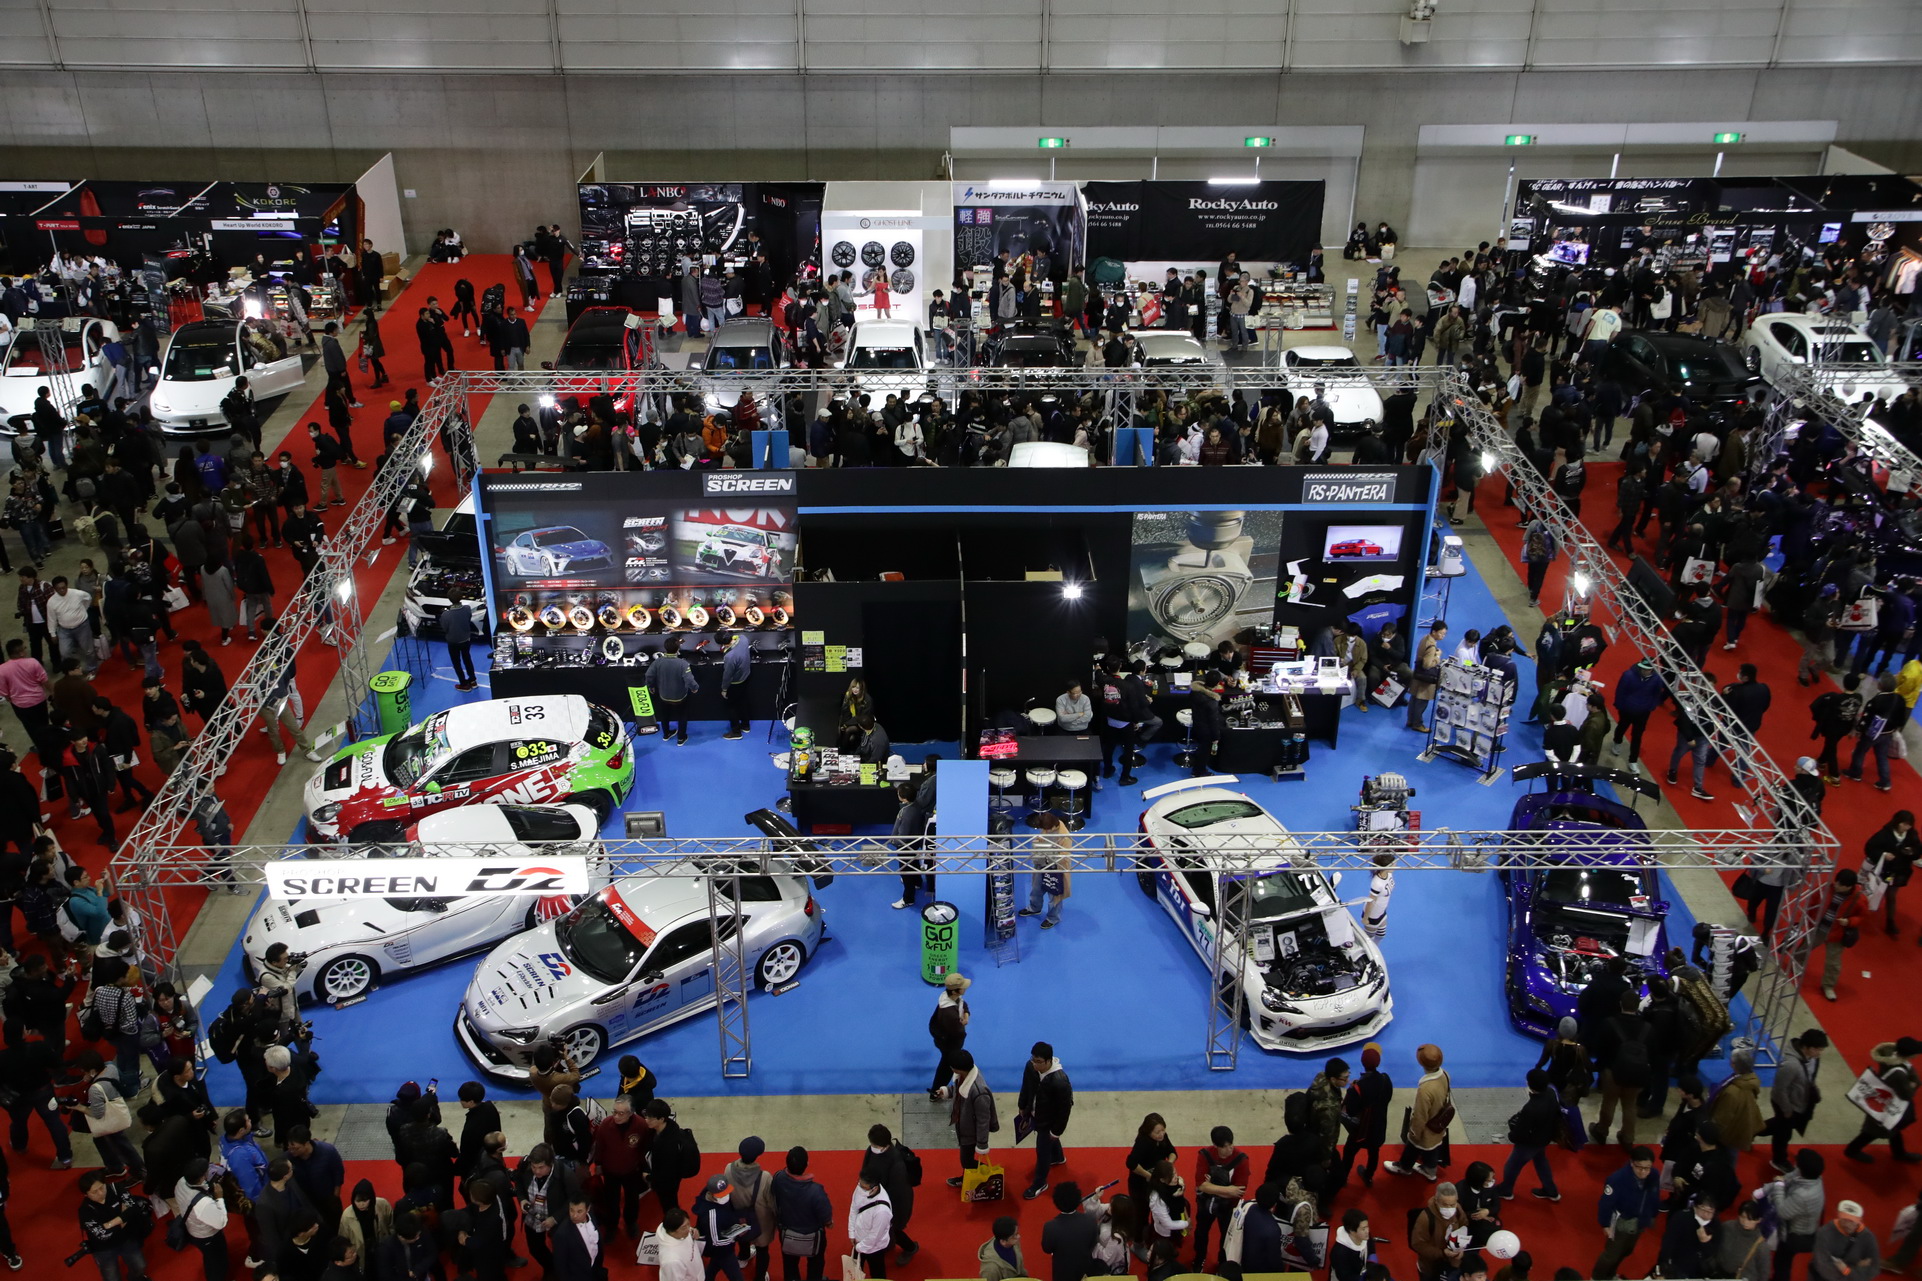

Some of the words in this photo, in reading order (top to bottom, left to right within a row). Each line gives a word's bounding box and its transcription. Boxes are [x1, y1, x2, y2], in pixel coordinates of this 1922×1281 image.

[1188, 198, 1279, 213] RockyAuto
[706, 478, 793, 492] SCREEN
[524, 705, 545, 721] 33
[597, 731, 611, 747] 33
[528, 741, 548, 757] 33
[510, 752, 560, 770] S.MAEJIMA
[413, 797, 423, 806] 33
[424, 793, 455, 805] TCR
[455, 789, 469, 797] TV
[282, 875, 438, 896] SCREEN
[925, 925, 953, 942] GO
[925, 940, 953, 952] &FUN
[522, 962, 547, 988] SCREEN
